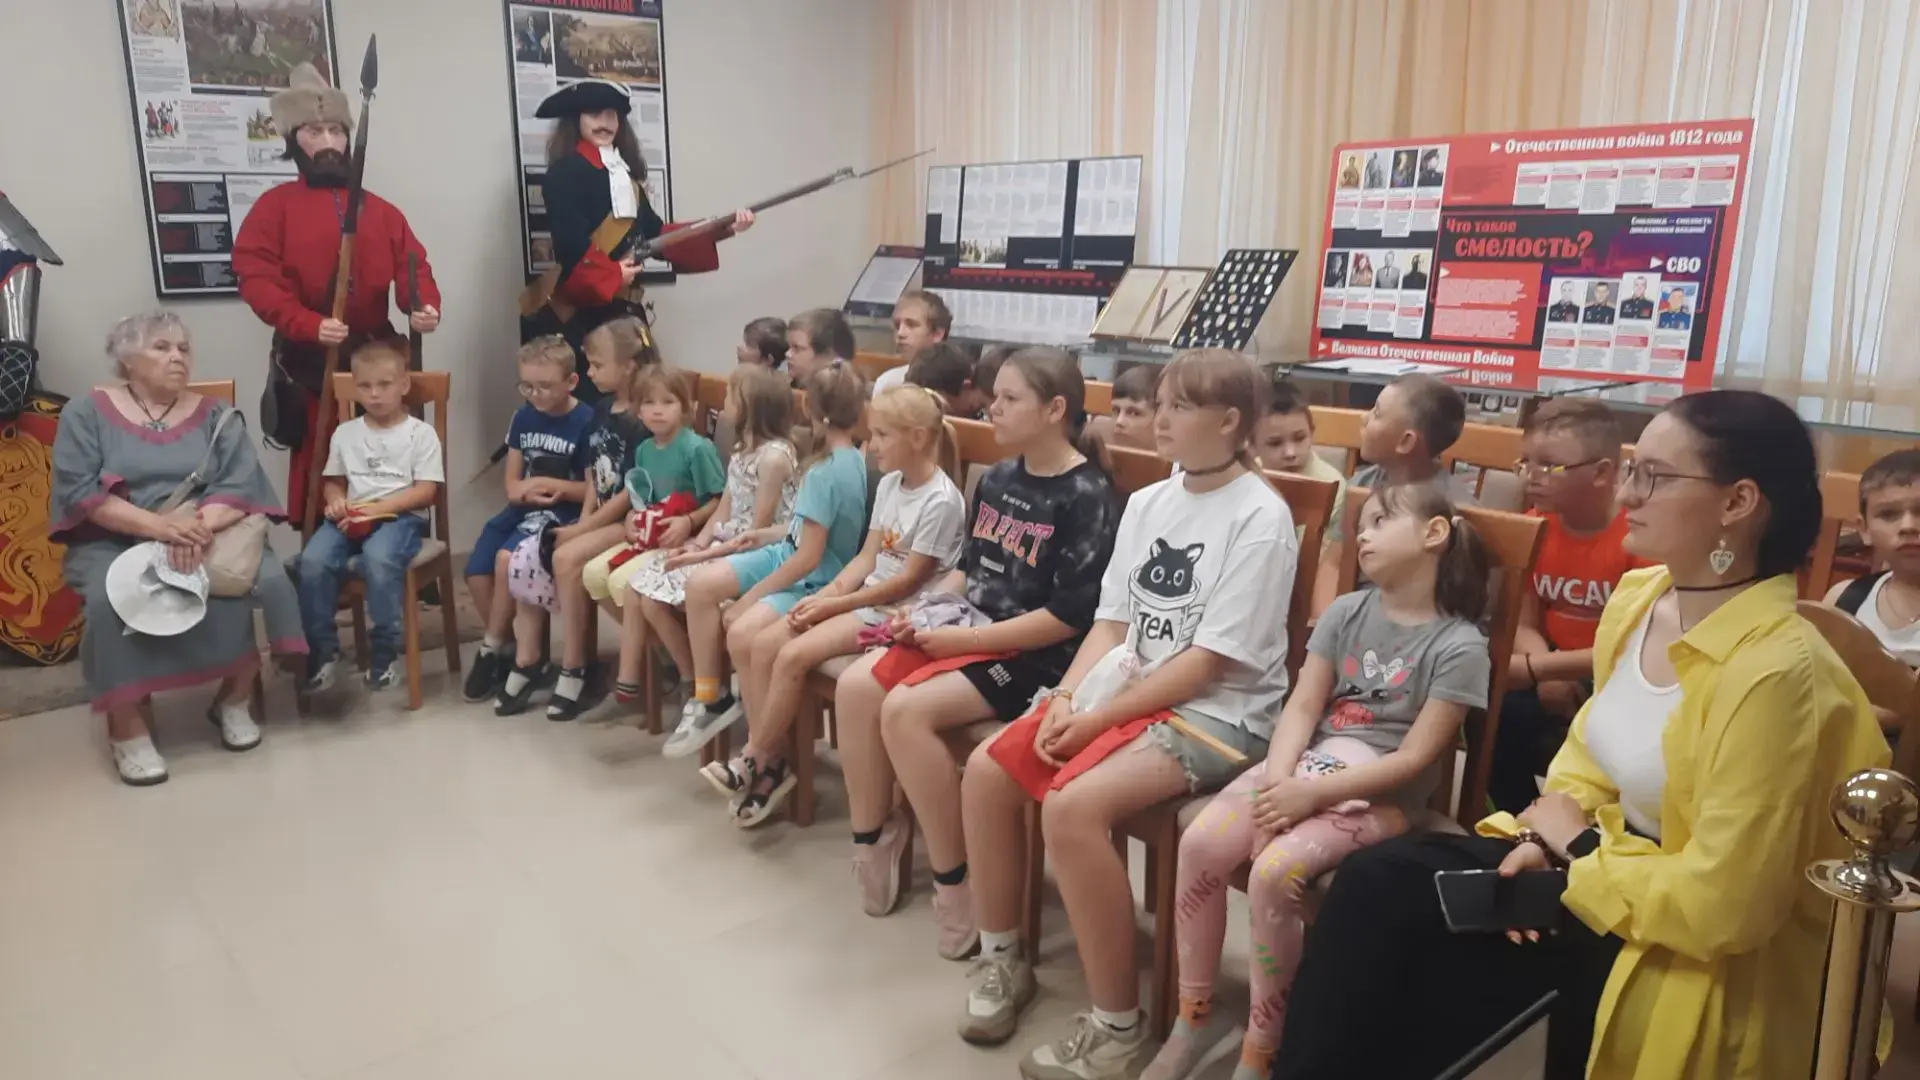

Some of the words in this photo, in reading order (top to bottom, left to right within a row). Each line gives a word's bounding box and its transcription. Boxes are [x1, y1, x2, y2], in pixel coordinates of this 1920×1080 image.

[1505, 137, 1615, 154] Отечественная
[1616, 132, 1665, 150] война
[1669, 129, 1703, 146] 1812
[1705, 129, 1744, 147] года
[1446, 217, 1471, 233] Что
[1474, 219, 1517, 233] такое
[1455, 230, 1594, 258] смелость?
[1666, 256, 1701, 273] СВО
[1331, 340, 1377, 356] Великая
[1379, 344, 1471, 364] Отечественная
[1472, 349, 1515, 366] Война
